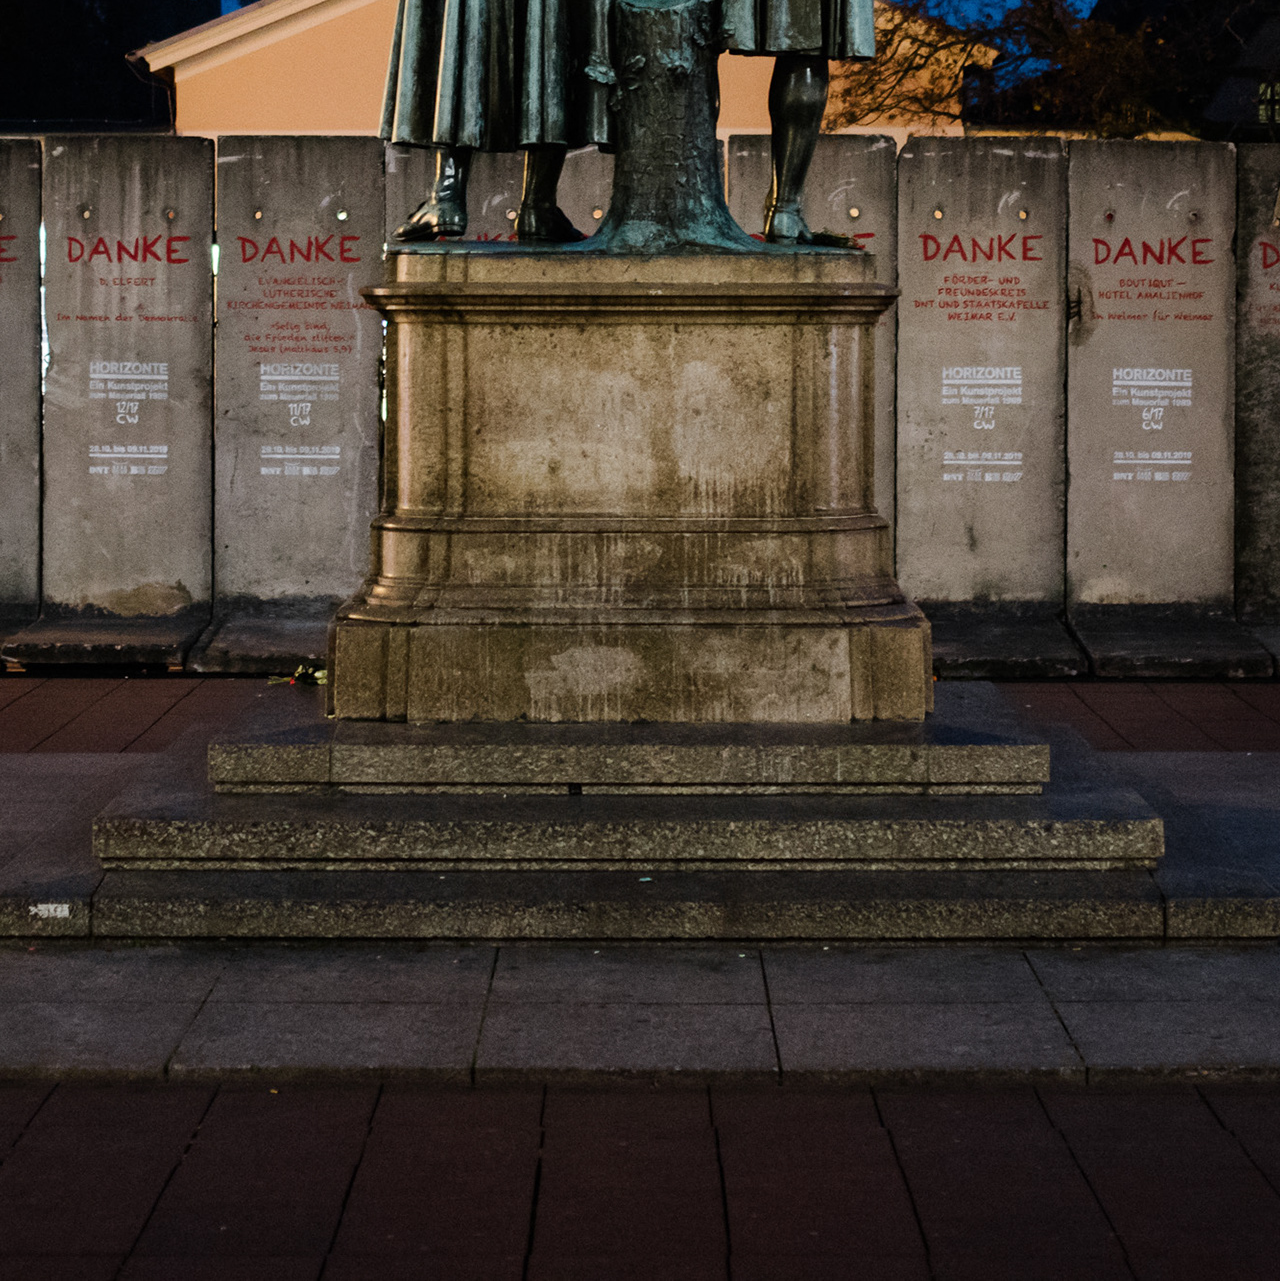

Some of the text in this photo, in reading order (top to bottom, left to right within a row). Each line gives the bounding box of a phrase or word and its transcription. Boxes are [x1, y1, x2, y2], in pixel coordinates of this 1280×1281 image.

[68, 234, 190, 263] DANKE
[237, 234, 360, 264] DANKE
[919, 233, 1042, 262] DANKE
[1093, 235, 1213, 264] DANKE
[112, 277, 155, 286] ELFERT
[999, 276, 1021, 285] UND
[263, 289, 338, 298] LUTHERISCHE
[938, 288, 1026, 297] FREUNDESKREIS
[1099, 291, 1203, 300] HOTEL AMALIENHOF
[914, 300, 1049, 309] DNT UND STAATSKAPELLE
[948, 312, 993, 321] WEIMAR
[90, 362, 168, 374] HORIZONTE
[261, 364, 339, 375] HORIZONTE
[942, 367, 1022, 379] HORIZONTE
[1113, 368, 1192, 380] HORIZONTE
[116, 402, 139, 413] 12/17
[288, 403, 311, 415] 11/17
[974, 406, 995, 418] 7/17
[116, 414, 139, 424] CW
[1142, 408, 1164, 419] 6/17
[290, 416, 310, 426] CW
[973, 420, 995, 430] CW
[1142, 422, 1163, 430] CW
